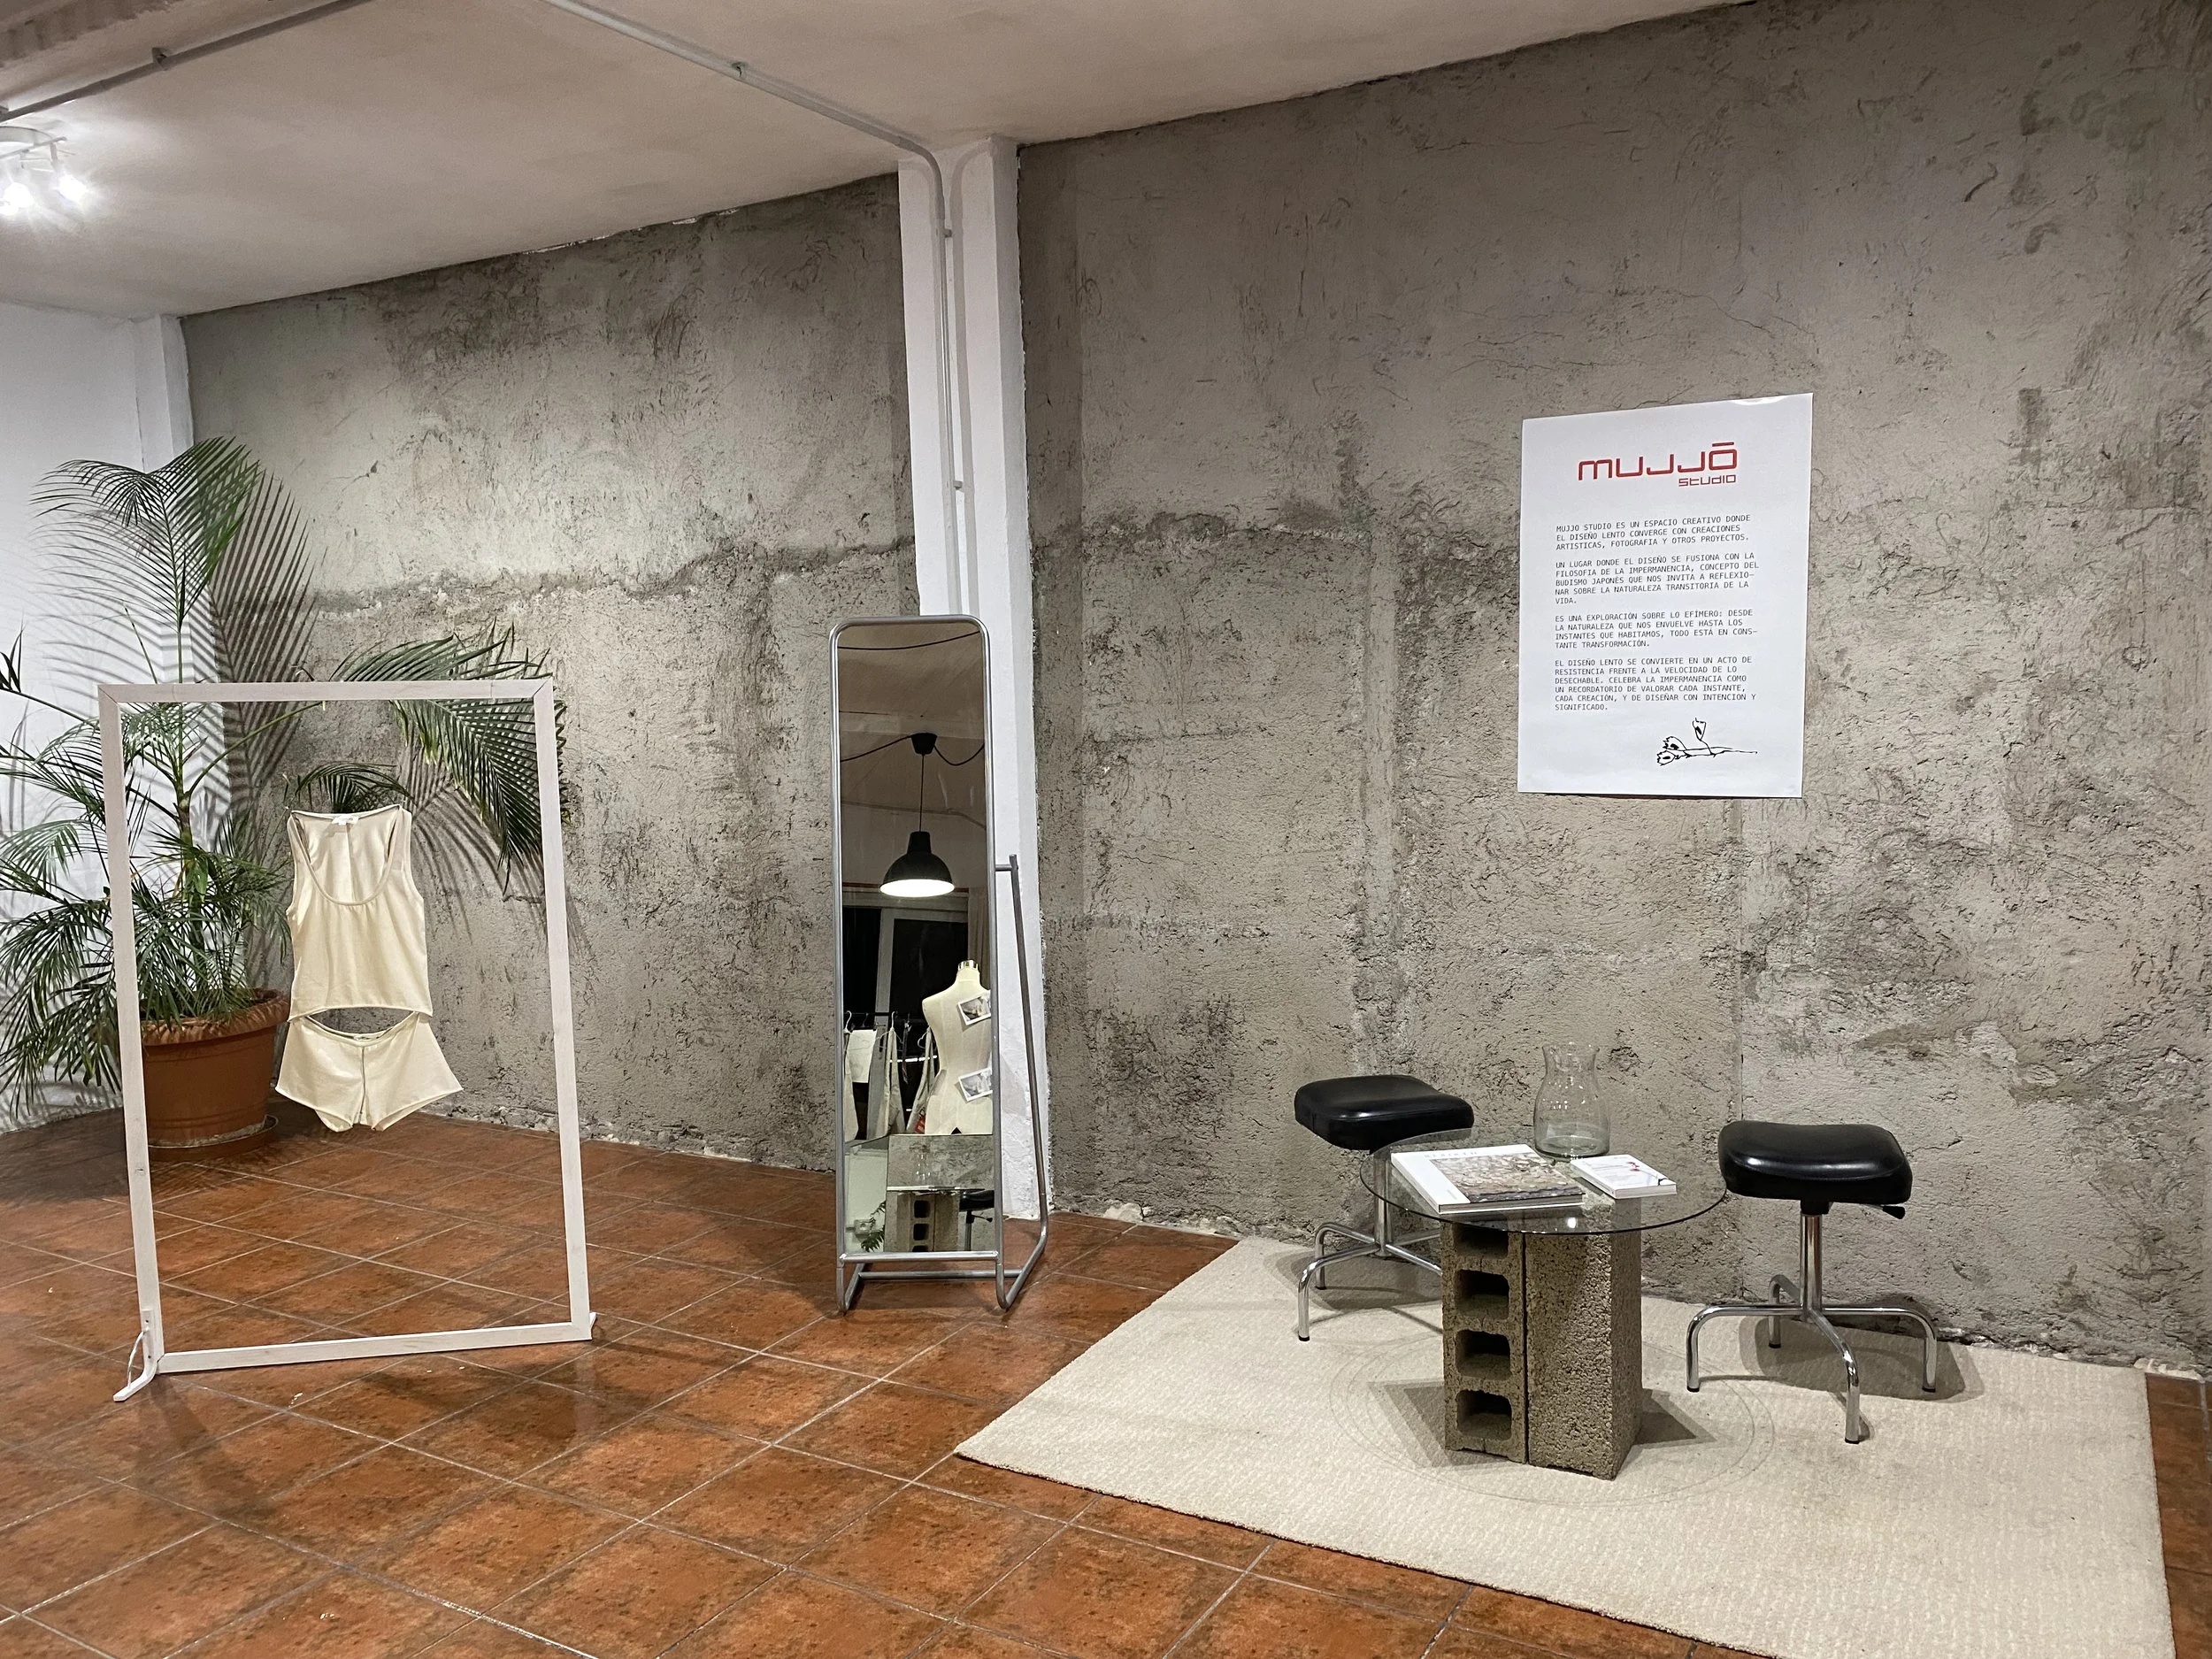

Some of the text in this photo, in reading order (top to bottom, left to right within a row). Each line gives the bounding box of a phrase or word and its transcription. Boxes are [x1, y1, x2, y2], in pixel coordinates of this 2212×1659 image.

[1555, 524, 1580, 533] MUJJO
[1584, 522, 1612, 531] STUDIO
[1644, 518, 1678, 527] ESPACIO
[1682, 516, 1722, 526] CREATIVO
[1725, 514, 1750, 523] DONDE
[1570, 531, 1598, 541] DISEÑO
[1601, 530, 1625, 539] LENTO
[1629, 528, 1668, 538] CONVERGE
[1691, 524, 1740, 534] CREACIONES
[1671, 536, 1696, 545] OTROS
[1701, 534, 1748, 543] PROYECTOS.
[1555, 560, 1565, 569] UN
[1569, 559, 1593, 568] LUGAR
[1596, 557, 1619, 567] DONDE
[1638, 555, 1667, 565] DISEÑO
[1671, 555, 1681, 564] SE
[1686, 553, 1720, 563] FUSIONA
[1724, 552, 1740, 561] CON
[1601, 567, 1610, 576] DE
[1629, 564, 1694, 575] IMPERMANENCIA,
[1700, 562, 1740, 572] CONCEPTO
[1743, 561, 1759, 570] DEL
[1592, 575, 1624, 585] JAPONÉS
[1666, 573, 1695, 582] INVITA
[1613, 584, 1662, 594] NATURALEZA
[1666, 582, 1719, 591] TRANSITORIA
[1586, 611, 1638, 622] EXPLORACIÓN
[1641, 611, 1665, 620] SOBRE
[1684, 609, 1723, 618] EFÍMERO:
[1728, 609, 1752, 618] DESDE
[1567, 622, 1615, 631] NATURALEZA
[1617, 630, 1664, 640] HABITAMOS,
[1694, 627, 1714, 636] ESTÁ
[1582, 639, 1650, 649] TRANSFORMACIÓN.
[1568, 657, 1596, 667] DISEÑO
[1555, 667, 1605, 676] RESISTENCIA
[1703, 684, 1745, 693] INSTANTE,
[1577, 694, 1617, 703] CREACIÓN,
[1645, 693, 1679, 702] DISEÑAR
